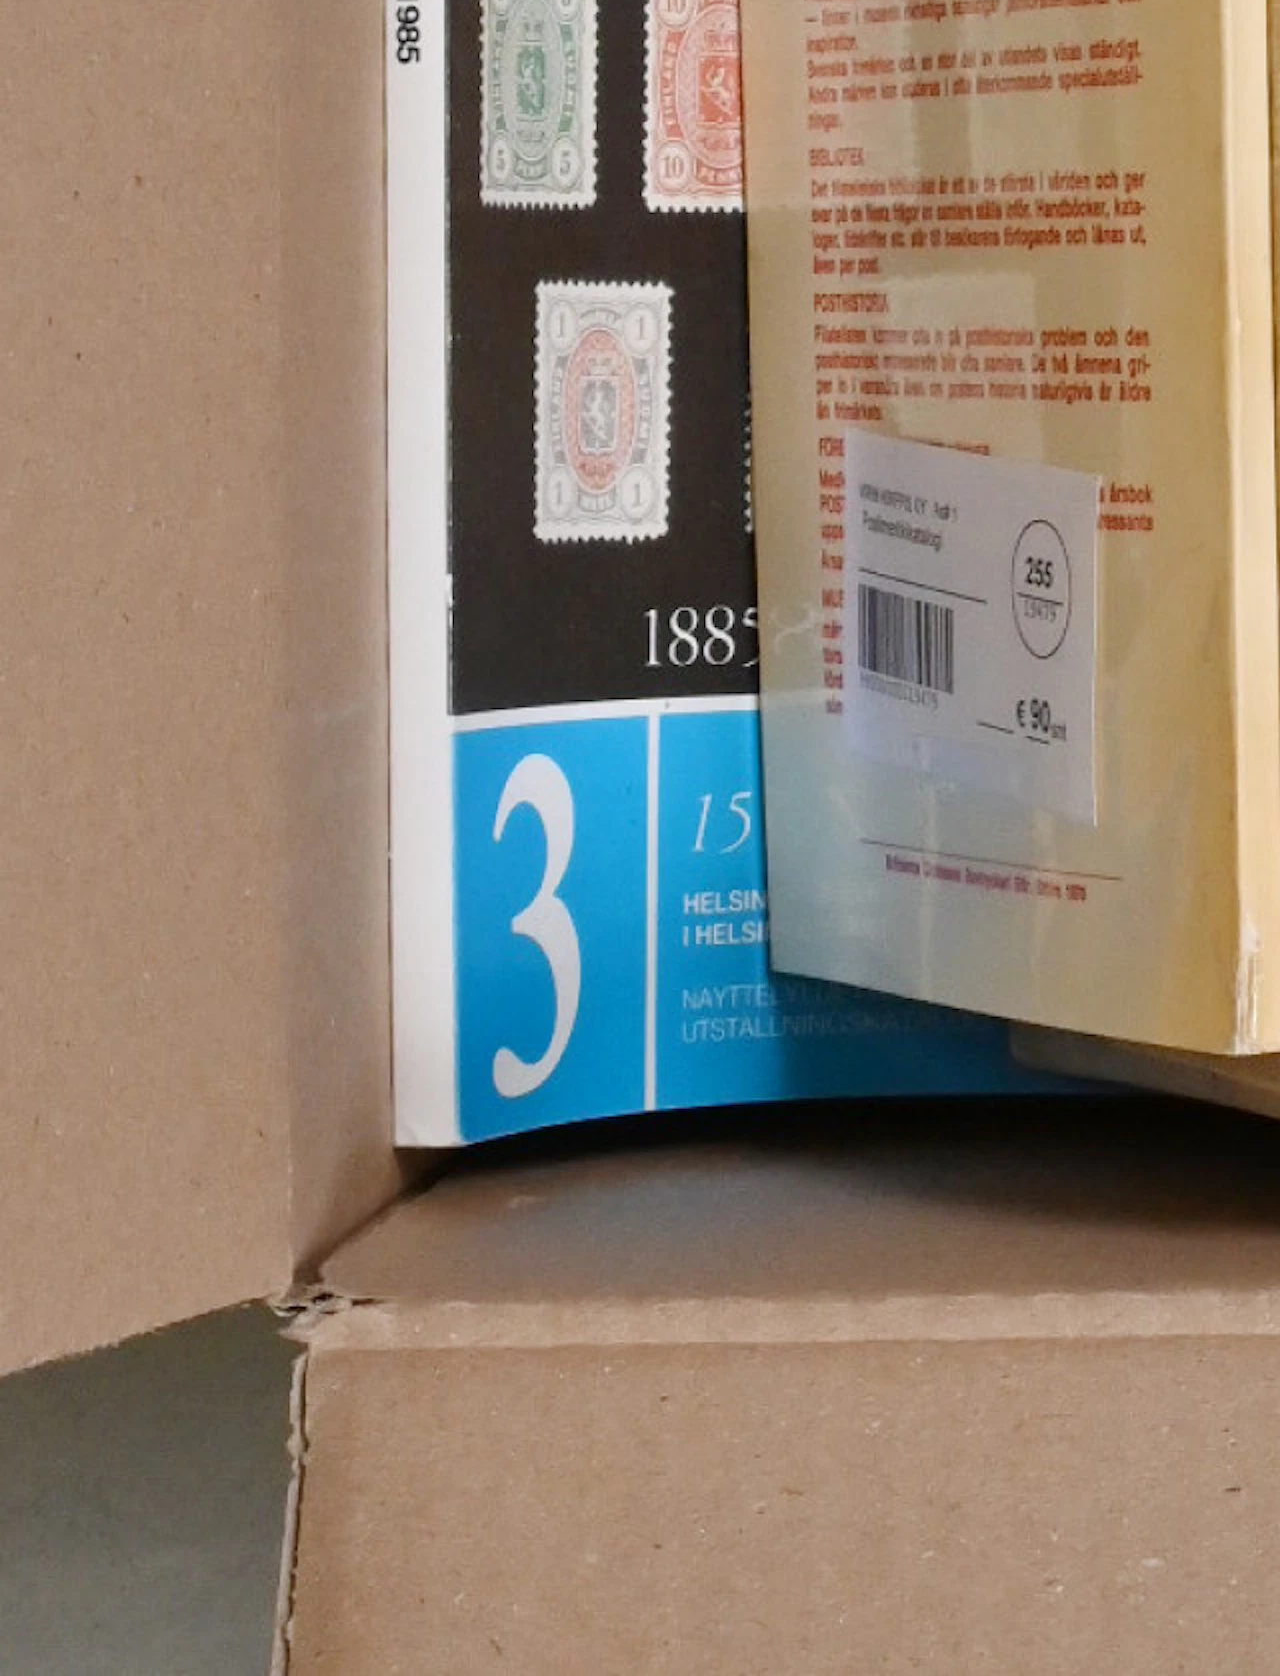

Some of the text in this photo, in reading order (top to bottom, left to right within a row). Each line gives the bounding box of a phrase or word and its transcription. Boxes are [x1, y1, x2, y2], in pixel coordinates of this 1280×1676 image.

[662, 155, 685, 180] 10
[1024, 556, 1054, 589] 255
[1030, 696, 1050, 735] 90
[492, 753, 583, 1100] 3
[695, 920, 765, 947] HELSI
